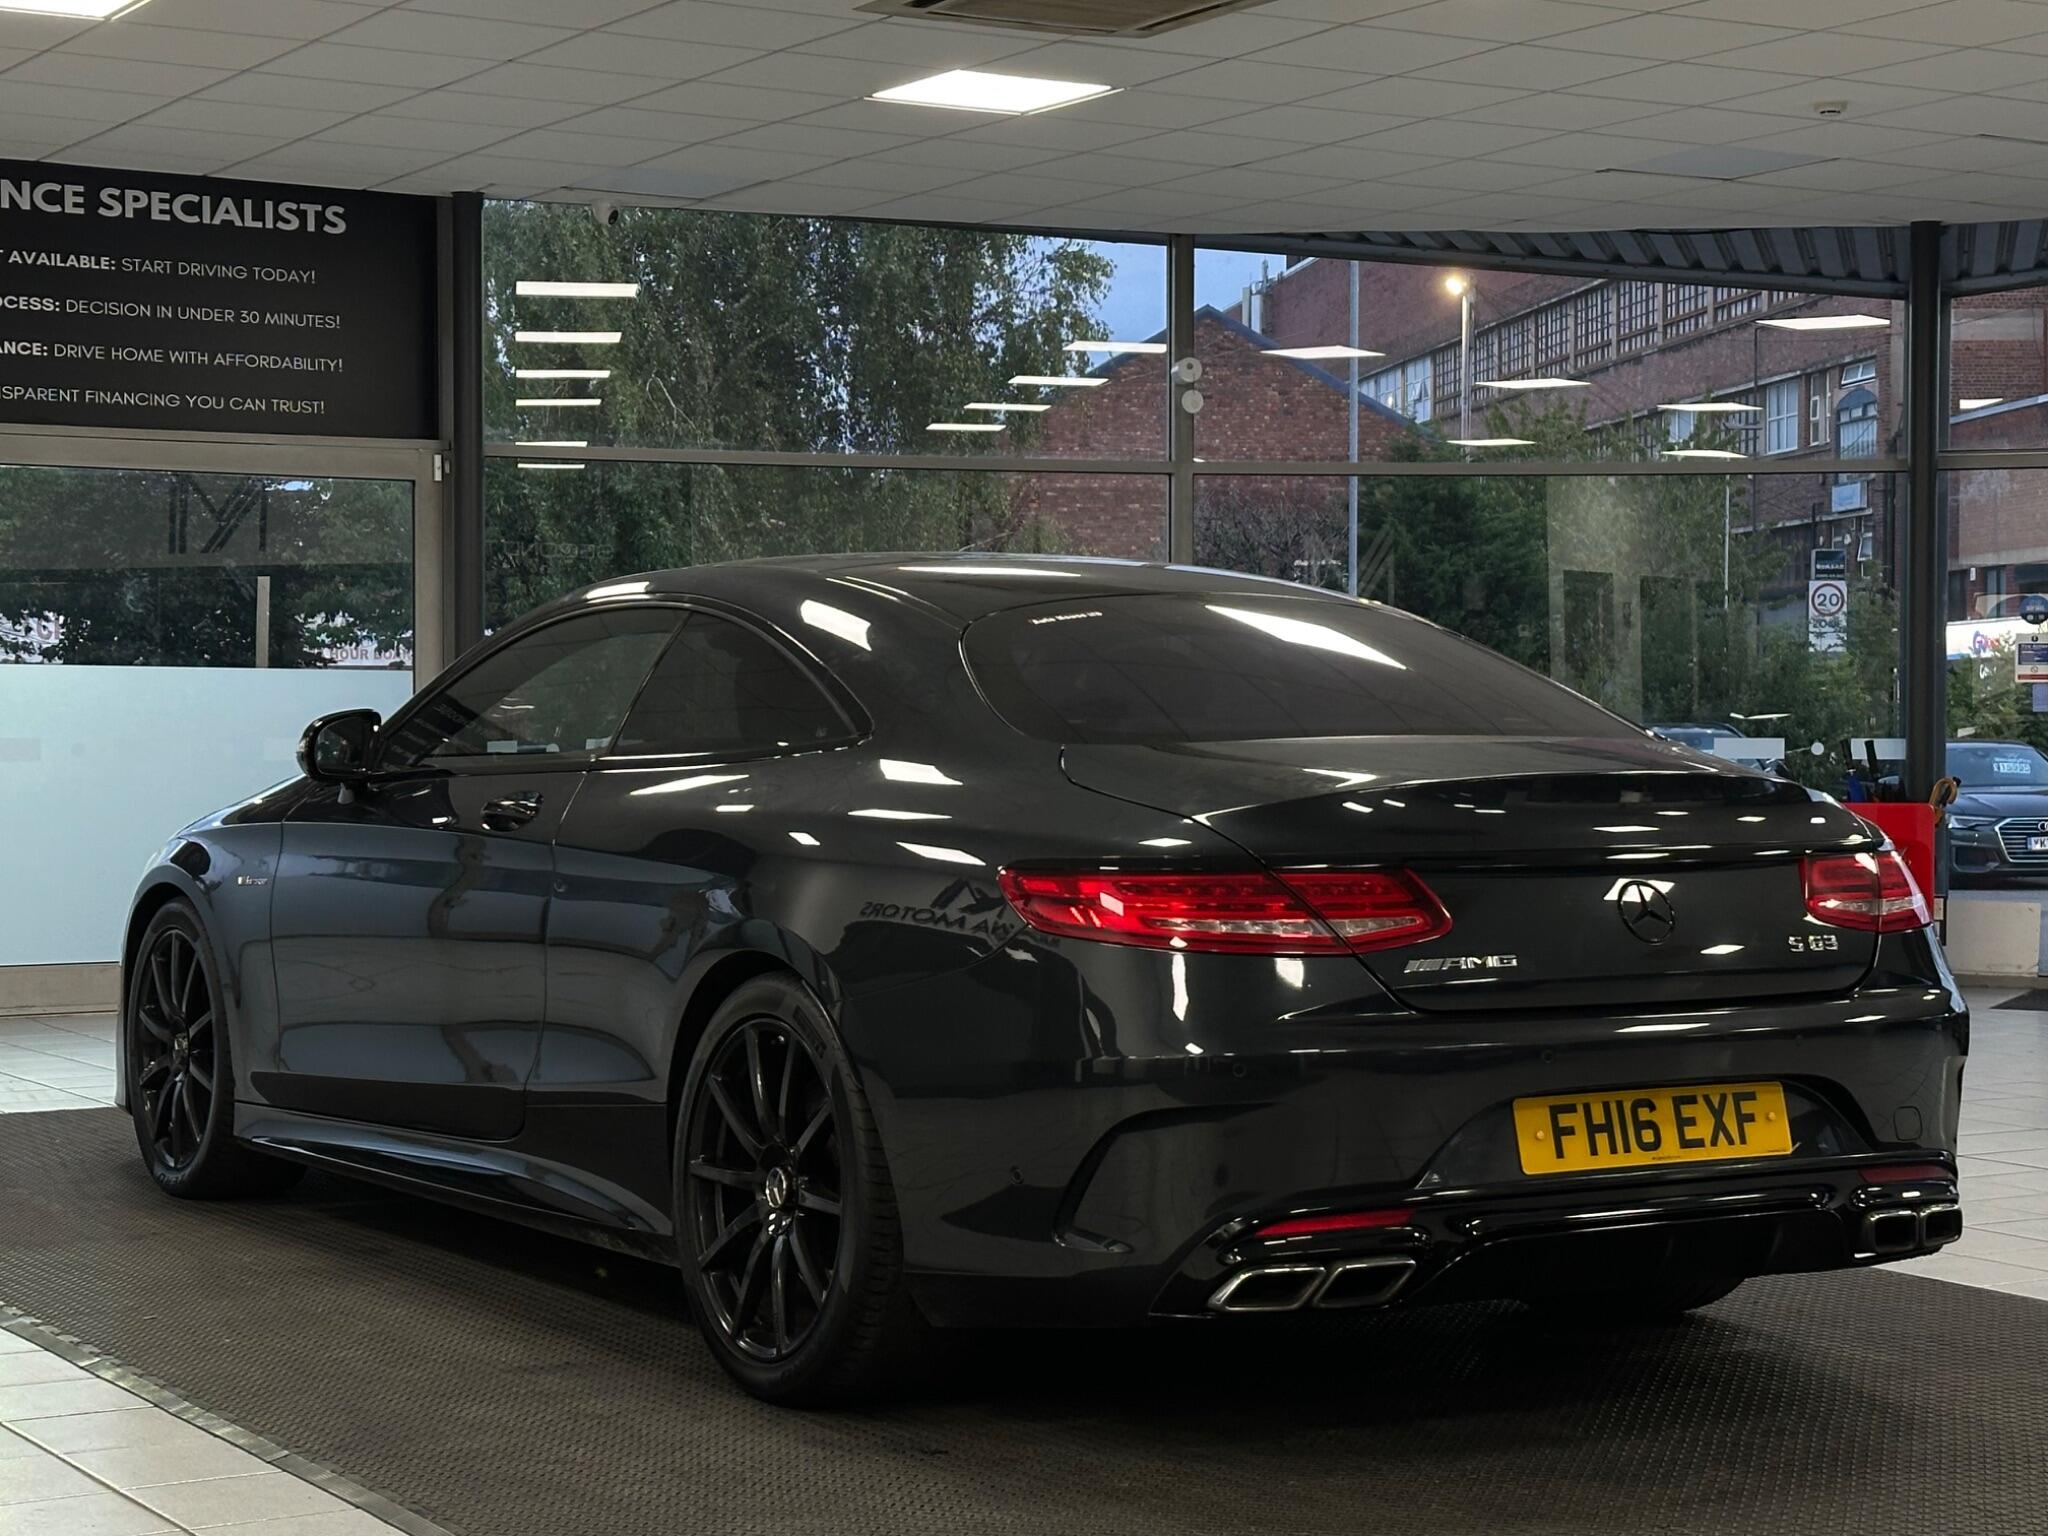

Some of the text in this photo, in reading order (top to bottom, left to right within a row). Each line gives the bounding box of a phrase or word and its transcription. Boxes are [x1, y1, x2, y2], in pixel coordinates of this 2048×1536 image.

[97, 187, 347, 234] SPECIALISTS
[8, 250, 116, 270] AVAILABLE:
[121, 258, 173, 274] START
[178, 262, 248, 279] DRIVING
[252, 267, 316, 284] TODAY!
[0, 295, 341, 329] CESS: DECISION IN UNDER 30 MINUTES!
[0, 340, 343, 372] NCE: DRIVE HOME WITH AFFORDABILITY!
[85, 390, 180, 407] FINANCING
[185, 394, 224, 410] YOU
[229, 397, 266, 412] CAN
[271, 399, 325, 414] TRUST!
[1817, 593, 1840, 607] 20
[1788, 934, 1838, 952] S 63
[1441, 955, 1517, 970] AMG
[1549, 1091, 1757, 1159] FH16 EXF
